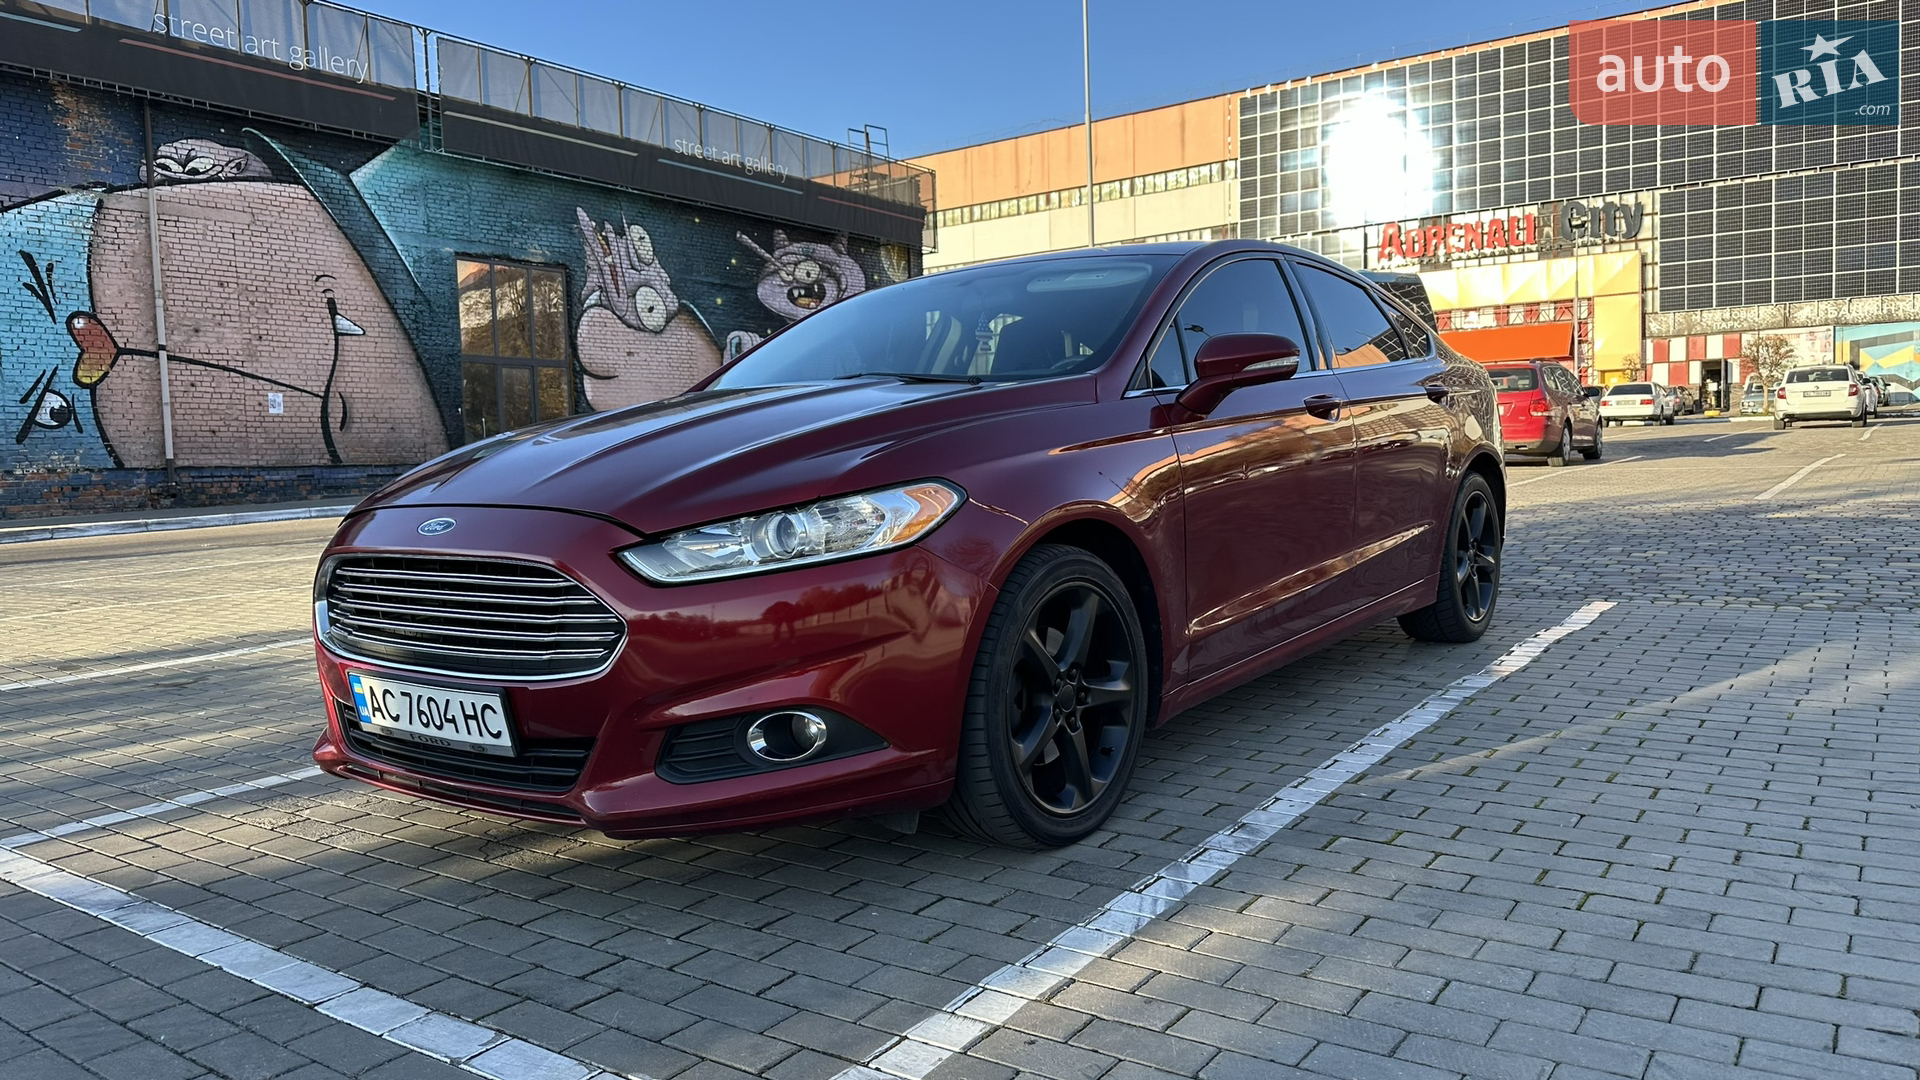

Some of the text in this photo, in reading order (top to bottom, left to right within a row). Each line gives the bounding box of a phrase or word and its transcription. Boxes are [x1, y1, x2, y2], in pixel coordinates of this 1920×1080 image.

[153, 12, 369, 84] street art gallery
[674, 138, 789, 183] street art gallery
[1713, 320, 1741, 330] ПАРК
[359, 705, 370, 717] UA
[410, 733, 451, 747] FORD
